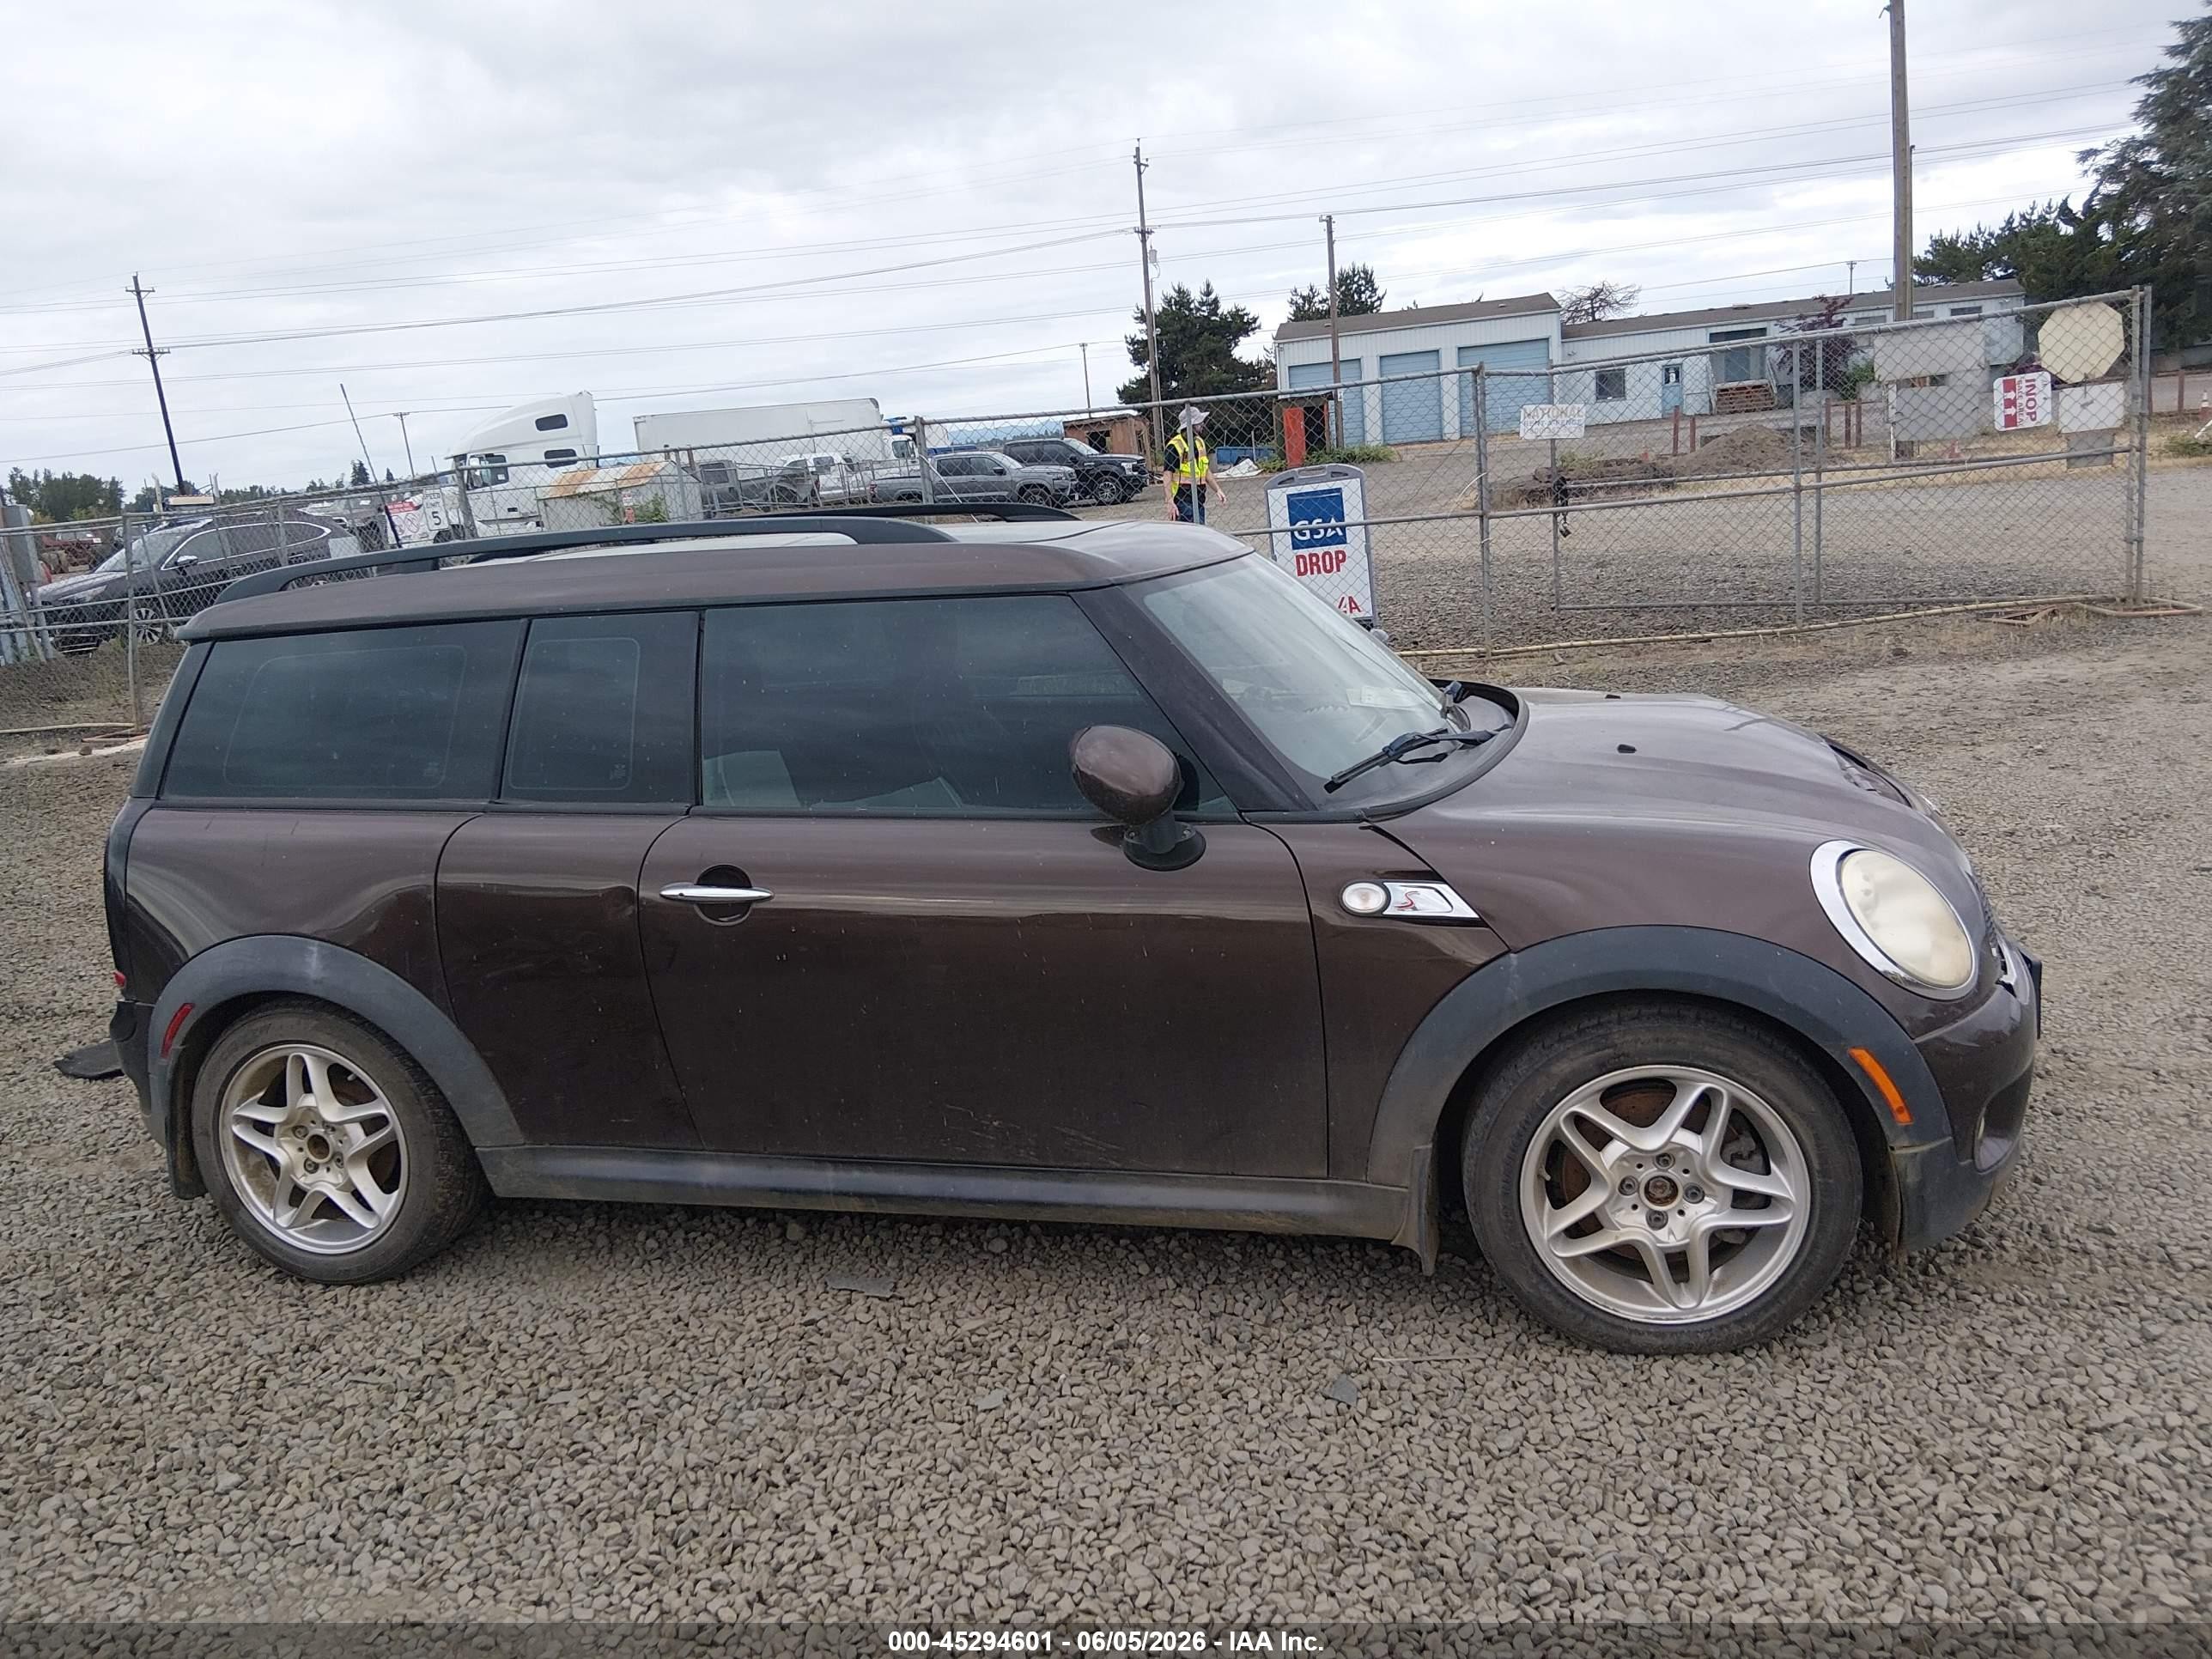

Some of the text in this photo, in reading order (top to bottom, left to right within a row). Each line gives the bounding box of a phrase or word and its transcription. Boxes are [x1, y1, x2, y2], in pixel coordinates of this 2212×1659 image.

[2025, 379, 2038, 422] INOP
[431, 511, 441, 526] 5
[1293, 518, 1343, 541] GSA
[1295, 550, 1347, 577] DROP
